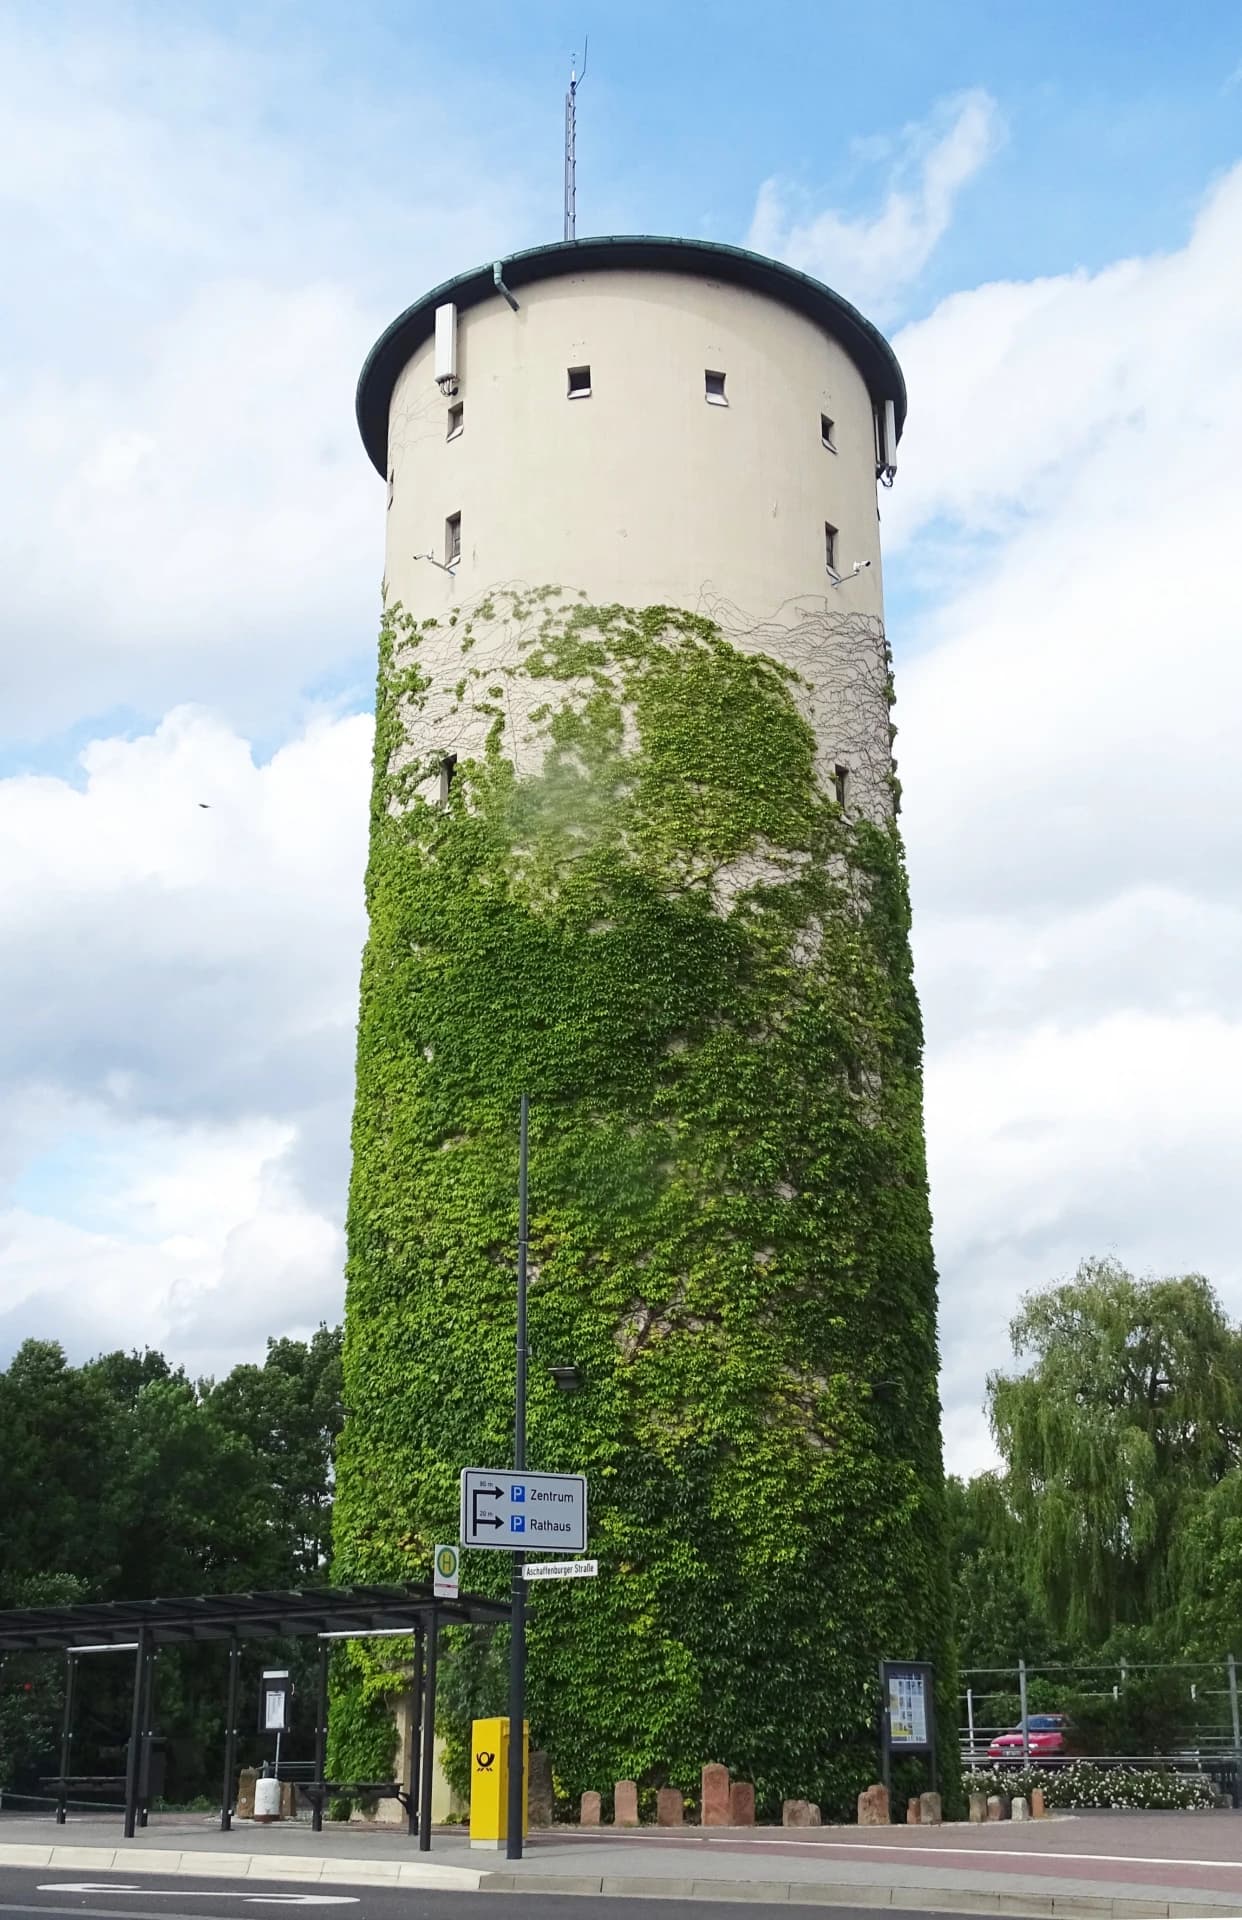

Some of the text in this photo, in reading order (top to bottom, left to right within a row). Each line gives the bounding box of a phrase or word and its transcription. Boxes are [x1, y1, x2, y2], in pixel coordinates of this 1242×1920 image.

[513, 1486, 574, 1503] P Zentrum
[513, 1516, 571, 1532] P Rathaus
[442, 1553, 451, 1571] H
[526, 1563, 594, 1576] Aschaffenburger Straße
